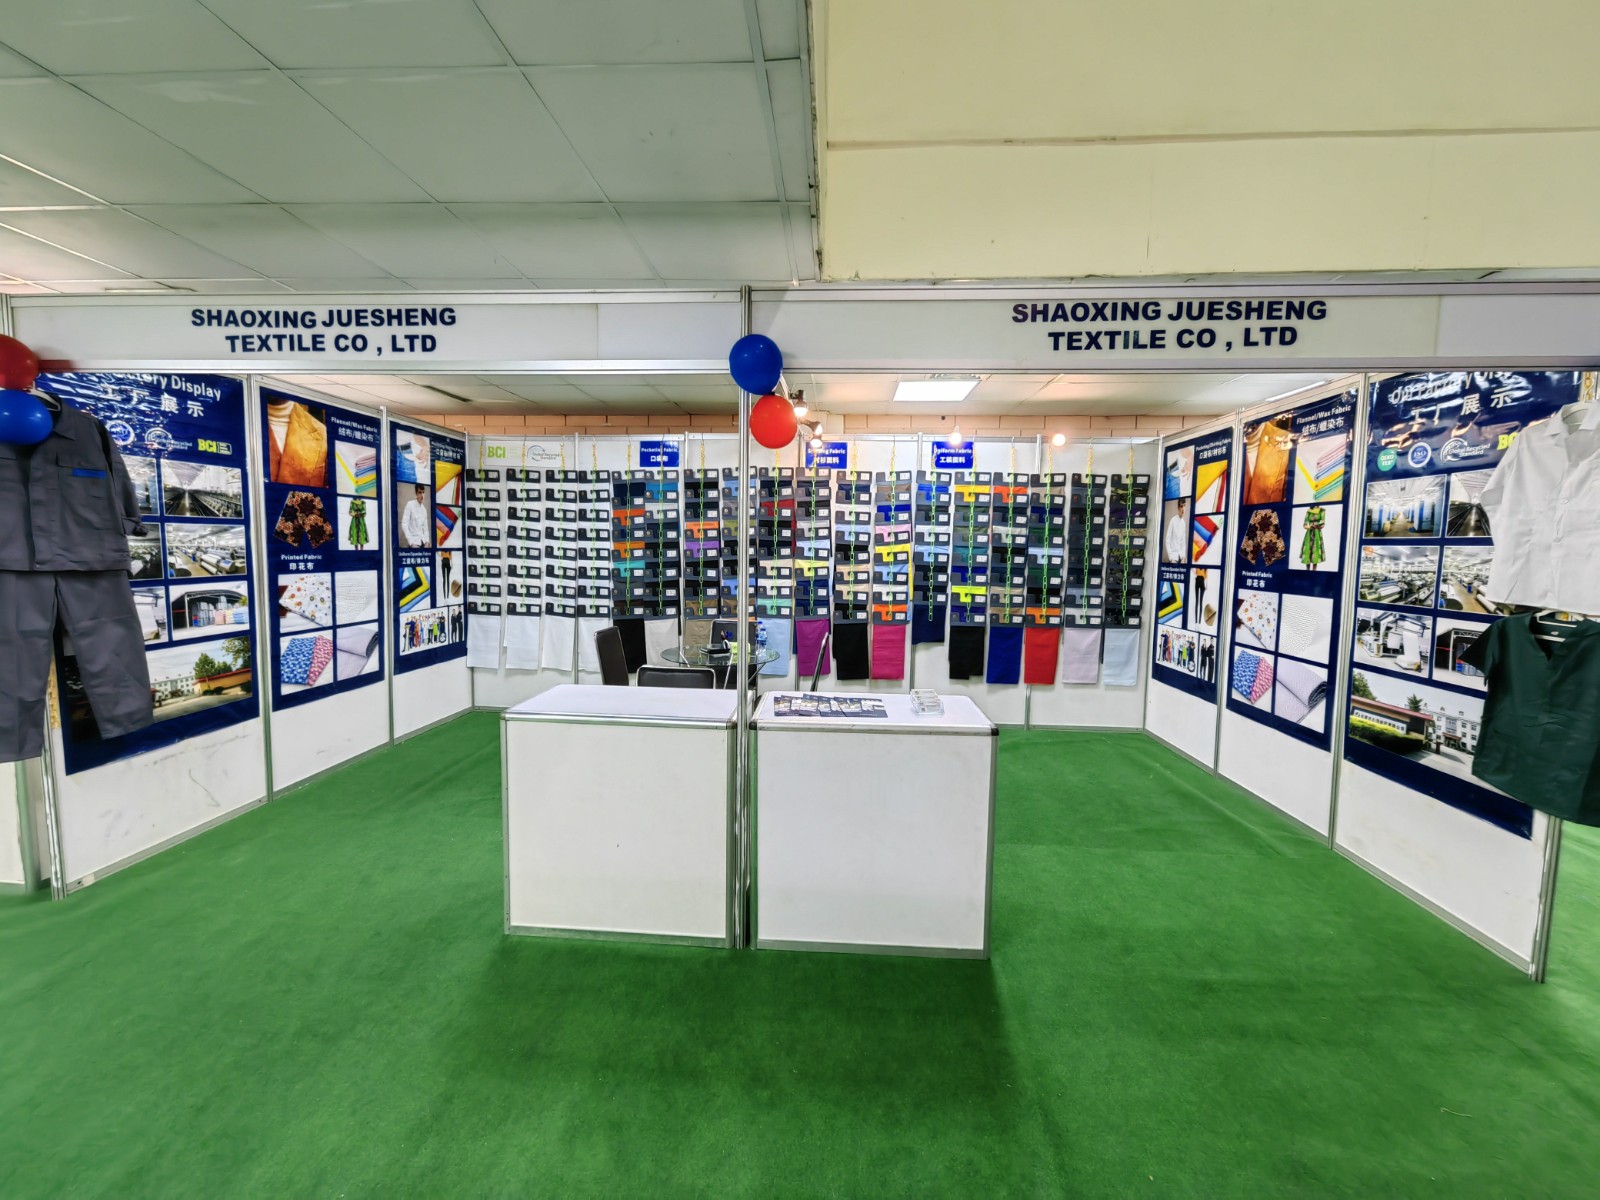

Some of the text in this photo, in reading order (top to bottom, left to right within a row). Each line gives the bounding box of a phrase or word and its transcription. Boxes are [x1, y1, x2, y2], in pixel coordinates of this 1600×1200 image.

[191, 308, 456, 329] SHAOXING JUESHENG
[1012, 300, 1327, 323] SHAOXING JUESHENG
[225, 334, 326, 353] TEXTILE
[391, 334, 437, 352] LTD
[1048, 329, 1166, 351] TEXTILE
[1243, 326, 1297, 347] LTD
[171, 374, 221, 402] Display
[1331, 404, 1352, 415] Fabric
[198, 438, 217, 453] BCI
[1497, 431, 1519, 450] BC
[487, 445, 506, 458] BCI
[289, 561, 315, 571] 印花布
[1246, 578, 1266, 588] 印花布
